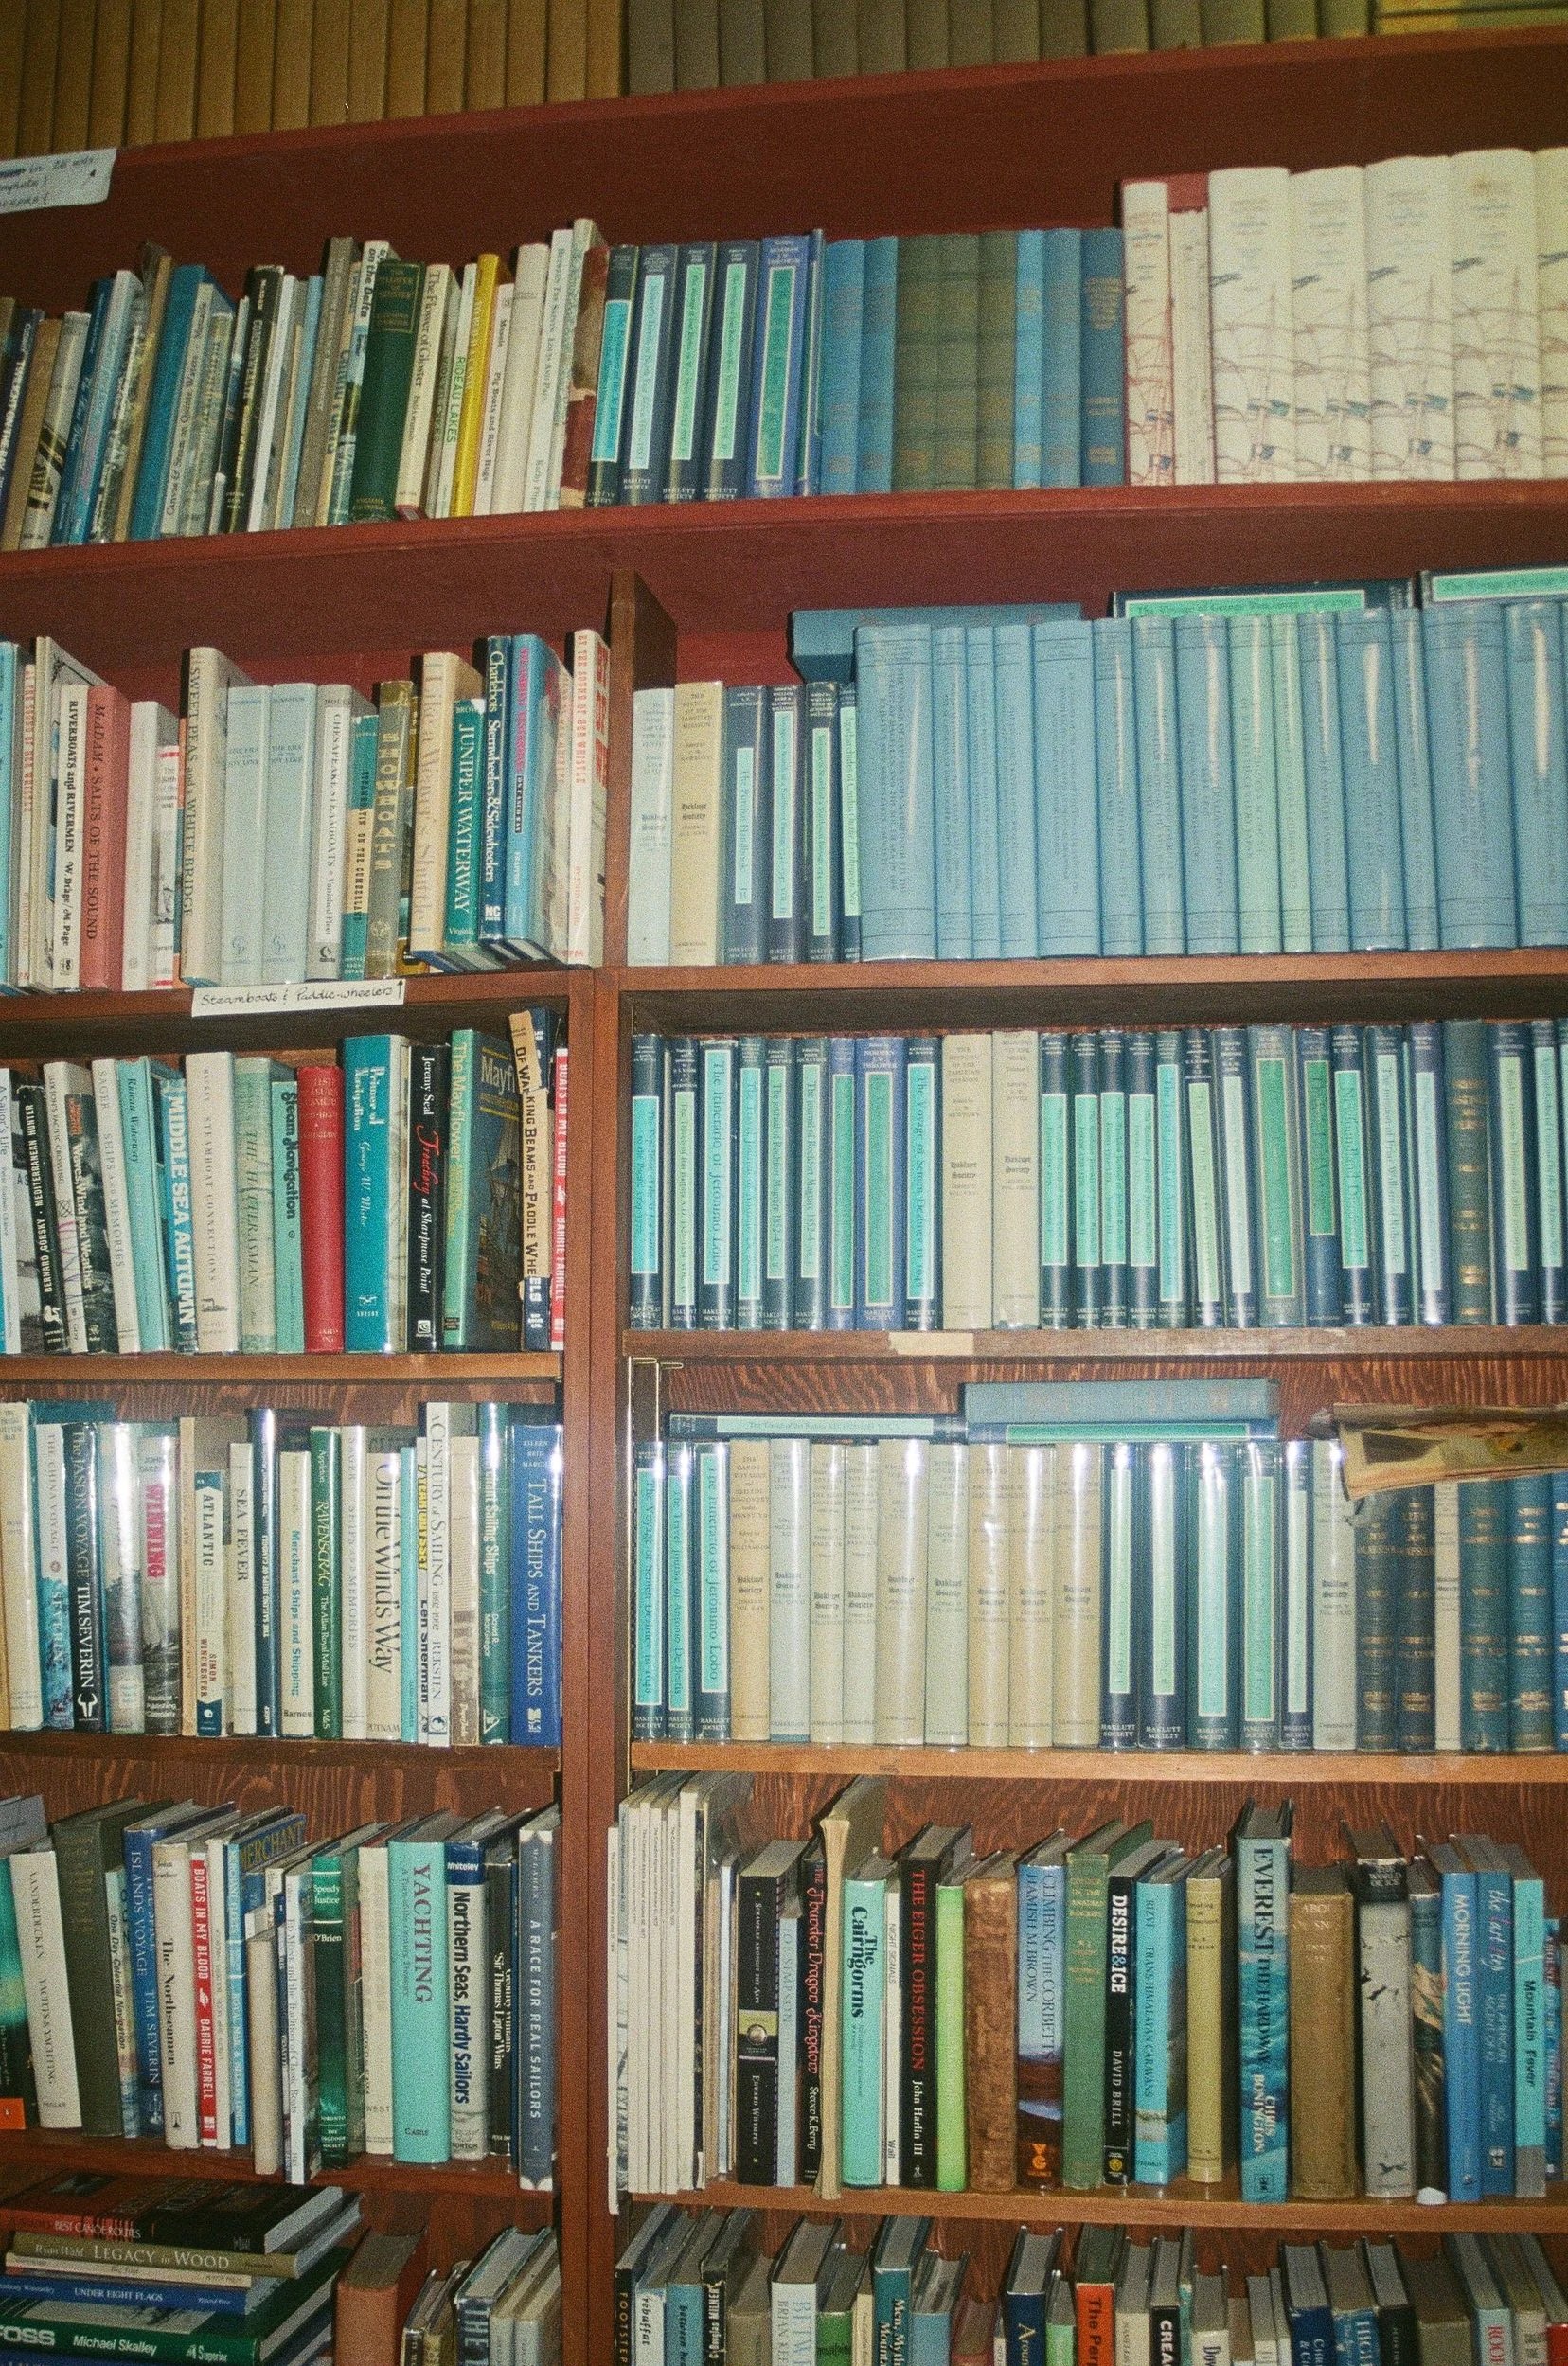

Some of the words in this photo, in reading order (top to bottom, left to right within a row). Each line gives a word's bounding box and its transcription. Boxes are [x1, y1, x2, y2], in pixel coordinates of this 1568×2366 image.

[366, 266, 376, 283] the
[368, 248, 376, 261] on
[362, 287, 375, 317] Delta
[430, 272, 440, 293] The
[422, 294, 437, 333] Flower
[417, 347, 429, 387] Gloster
[451, 357, 465, 400] RIDEAU
[446, 404, 460, 442] LAKES
[489, 651, 505, 713] Charlebois
[65, 701, 78, 768] RIVERBOATS
[92, 703, 104, 761] McADAM
[64, 772, 76, 790] and
[458, 723, 475, 803] JUNIPER
[90, 775, 102, 821] SALTS
[64, 792, 76, 852] RIVERMEN
[89, 827, 100, 845] OF
[88, 853, 100, 881] THE
[455, 807, 472, 914] WATERWAY
[86, 887, 99, 939] SOUND
[202, 993, 277, 1005] Steamboats
[297, 987, 393, 1003] Paddle-wheelers
[420, 1056, 435, 1090] Jeremy
[453, 1043, 465, 1071] The
[713, 1060, 727, 1086] The
[26, 1105, 35, 1136] HUNTER
[282, 1092, 298, 1135] Steam
[423, 1094, 435, 1115] Seal
[449, 1076, 465, 1162] Mayflower
[168, 1096, 187, 1178] MIDDLE
[28, 1140, 45, 1207] MEDITERRANEAN
[282, 1138, 299, 1219] Navigation
[413, 1124, 440, 1194] Treachery
[172, 1183, 189, 1224] SEA
[420, 1197, 431, 1208] at
[37, 1219, 48, 1252] GORSKY
[418, 1212, 432, 1262] Sharpnose
[712, 1236, 724, 1271] Lobo
[41, 1254, 52, 1292] BERNARD
[176, 1230, 194, 1325] AUTUMN
[419, 1266, 431, 1292] Point
[72, 1432, 85, 1457] The
[431, 1422, 445, 1501] CENTURY
[73, 1458, 88, 1508] JASON
[375, 1463, 400, 1497] On
[527, 1478, 546, 1523] TALL
[237, 1488, 248, 1518] SEA
[375, 1503, 399, 1540] the
[76, 1514, 91, 1577] VOYAGE
[146, 1483, 165, 1578] WINNING
[203, 1494, 215, 1566] ATLANTIC
[316, 1500, 331, 1589] RAVENSCRAG
[237, 1528, 248, 1581] FEVER
[291, 1530, 301, 1583] Merchant
[431, 1520, 445, 1587] SAILING
[527, 1528, 547, 1578] SHIPS
[77, 1582, 92, 1614] TIM
[375, 1543, 400, 1618] Wind's
[527, 1584, 540, 1611] AND
[290, 1588, 301, 1619] Ships
[79, 1618, 94, 1687] SEVERIN
[291, 1623, 301, 1643] and
[368, 1620, 400, 1674] Way
[200, 1637, 208, 1697] WINCHESTER
[209, 1654, 218, 1682] SIMON
[289, 1647, 301, 1696] Shipping
[527, 1614, 547, 1696] TANKERS
[131, 1851, 144, 1912] ISLANDS
[193, 1867, 206, 1902] BOATS
[314, 1885, 340, 1895] Speedy
[314, 1895, 340, 1904] Justice
[912, 1870, 925, 1905] THE
[1025, 1875, 1038, 1929] HAMISH
[1254, 1847, 1275, 1955] EVEREST
[110, 1914, 119, 1933] One
[195, 1906, 206, 1919] IN
[196, 1923, 207, 1941] MY
[454, 1891, 472, 1963] Northern
[530, 1920, 541, 1929] A
[807, 1887, 824, 1949] Thunder
[1042, 1875, 1056, 1951] CLIMBING
[109, 1937, 120, 1954] Day
[134, 1918, 148, 1977] VOYAGE
[162, 1937, 173, 1965] The
[313, 1934, 342, 1943] O'Brien
[412, 1864, 433, 2004] YACHTING
[530, 1935, 541, 1972] RACE
[864, 1936, 879, 1965] The
[912, 1911, 925, 1965] EIGER
[1454, 1894, 1470, 1976] MORNING
[112, 1958, 123, 1998] Celestial
[197, 1944, 209, 1979] BLOOD
[847, 1906, 868, 2019] Cairngorms
[1025, 1949, 1038, 2002] BROWN
[1042, 1954, 1052, 1978] THE
[1257, 1957, 1273, 1986] THE
[453, 1966, 472, 2001] Seas,
[530, 1979, 541, 2006] FOR
[1457, 1981, 1471, 2024] LIGHT
[145, 1990, 156, 2019] TIM
[163, 1973, 176, 2065] Northseamen
[912, 1969, 925, 2071] OBSESSION
[1041, 1979, 1057, 2060] CORBETTS
[1257, 1989, 1273, 2032] HARD
[1524, 1981, 1537, 2042] Mountain
[115, 2001, 127, 2050] Navigation
[200, 2018, 212, 2054] BARRIE
[452, 2004, 472, 2050] Hardy
[530, 2013, 541, 2050] REAL
[806, 2007, 822, 2074] Kingdom
[148, 2022, 160, 2083] SEVERIN
[1112, 2050, 1124, 2086] DAVID
[1257, 2032, 1273, 2064] WAY
[1524, 2049, 1537, 2087] Fever
[201, 2057, 214, 2100] FARRELL
[454, 2053, 472, 2104] Sailors
[530, 2055, 541, 2118] SAILORS
[912, 2080, 923, 2104] John
[912, 2107, 923, 2140] Harlin
[1112, 2090, 1124, 2126] BRILL
[1253, 2074, 1266, 2152] BONINGTON
[1265, 2095, 1276, 2136] CHRIS
[913, 2143, 924, 2155] III
[93, 2245, 156, 2264] LEGACY
[174, 2250, 230, 2269] WOOD
[74, 2286, 105, 2299] UNDER
[107, 2288, 134, 2300] EIGHT
[135, 2290, 164, 2302] FLAGS
[73, 2335, 116, 2351] Michael
[118, 2338, 158, 2357] Skalley
[678, 2304, 689, 2347] between
